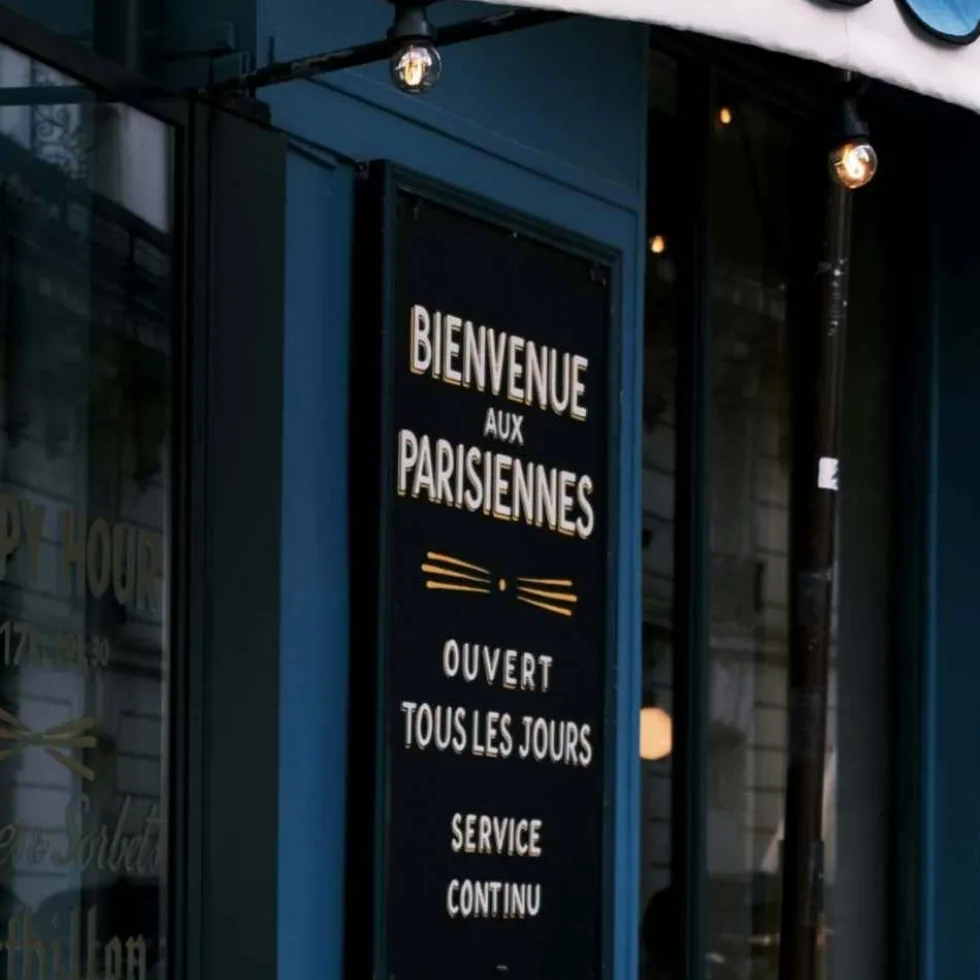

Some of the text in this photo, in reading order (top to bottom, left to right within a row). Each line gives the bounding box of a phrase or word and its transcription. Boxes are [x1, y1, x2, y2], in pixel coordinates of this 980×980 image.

[409, 303, 589, 422] BIENVENUE
[483, 407, 525, 446] AUX
[397, 429, 595, 540] PARISIENNES
[59, 507, 164, 613] HOUR
[442, 639, 554, 691] OUVERT
[400, 701, 594, 768] TOUS LES JOURS
[450, 812, 543, 857] SERVICE
[446, 878, 542, 919] CONTINU
